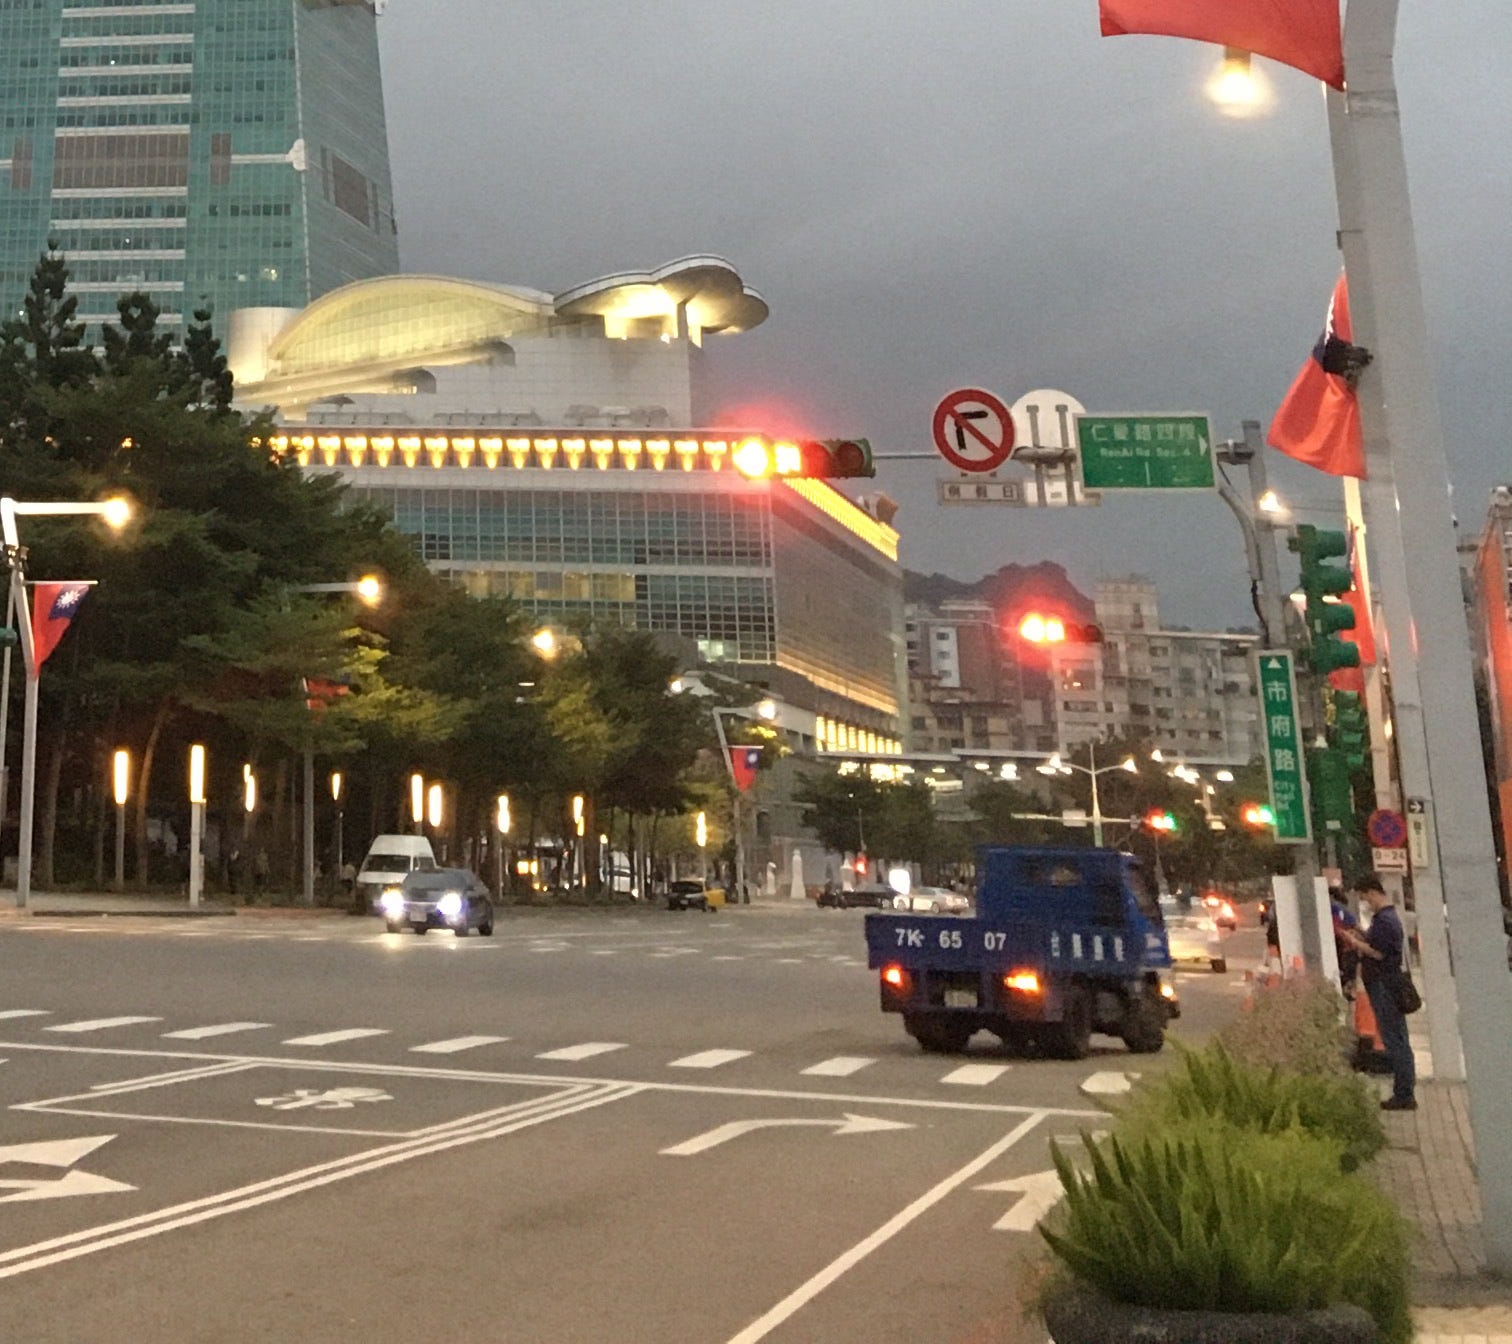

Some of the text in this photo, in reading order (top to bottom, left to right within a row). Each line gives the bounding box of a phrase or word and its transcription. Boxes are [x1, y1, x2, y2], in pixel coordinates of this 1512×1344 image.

[1265, 679, 1295, 772] 市府路
[938, 930, 963, 950] 65
[983, 931, 1008, 951] 07
